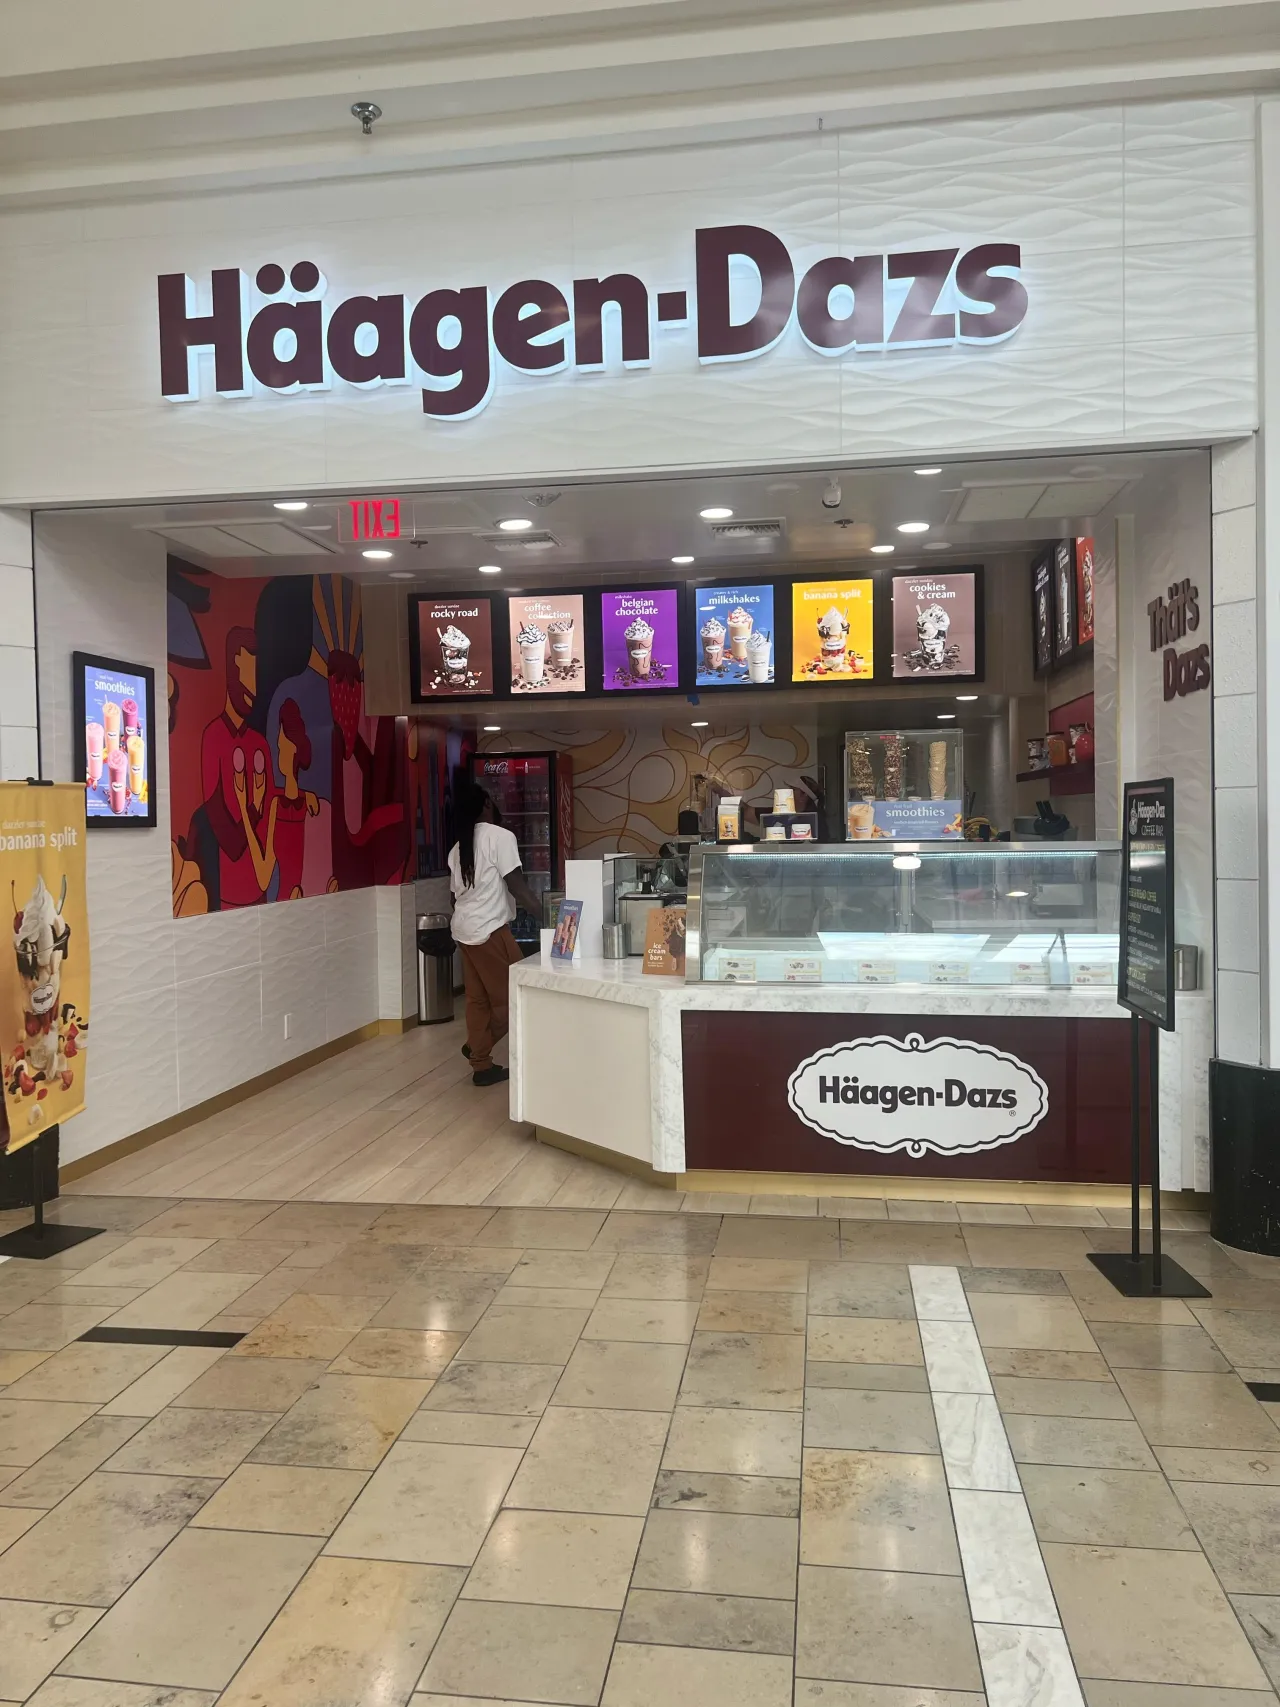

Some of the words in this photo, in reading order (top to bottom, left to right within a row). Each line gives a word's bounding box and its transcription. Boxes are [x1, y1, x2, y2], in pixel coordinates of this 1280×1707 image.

[158, 225, 1029, 415] Häagen-Dazs
[909, 582, 946, 592] cookies
[709, 594, 760, 605] milkshakes
[803, 590, 838, 600] banana
[840, 588, 862, 600] split
[917, 592, 926, 600] &
[927, 591, 956, 599] cream
[524, 602, 552, 612] coffee
[621, 598, 654, 609] belgian
[430, 608, 456, 619] rocky
[457, 607, 478, 617] road
[528, 611, 571, 620] collection
[615, 606, 658, 616] chocolate
[1163, 644, 1210, 701] Dazs
[94, 680, 135, 697] smoothies
[886, 806, 945, 817] smoothies
[0, 828, 46, 851] banana
[50, 826, 78, 852] split
[819, 1075, 1018, 1113] Häagen-Dazs
